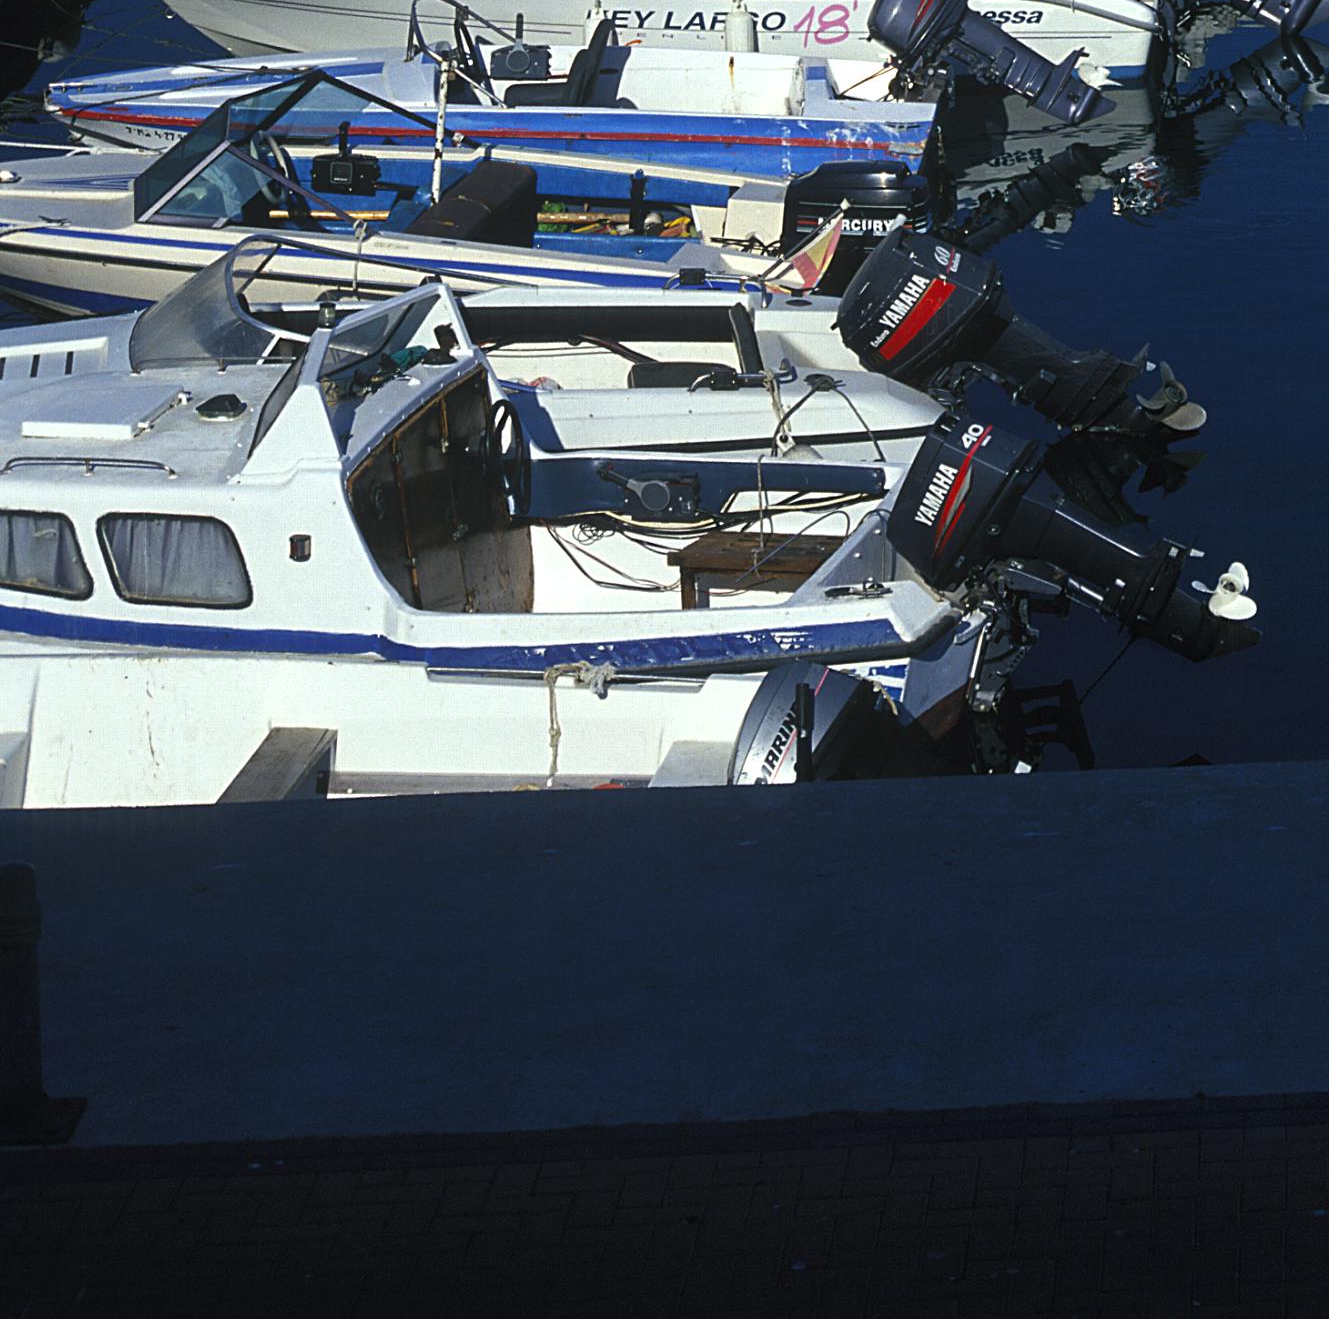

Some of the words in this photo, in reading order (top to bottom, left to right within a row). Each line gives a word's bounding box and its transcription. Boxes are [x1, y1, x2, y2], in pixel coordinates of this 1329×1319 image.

[978, 10, 1043, 24] essa
[818, 217, 895, 231] RCURY
[934, 246, 951, 266] 60
[879, 274, 930, 329] YAMAHA
[961, 423, 984, 449] 40
[915, 463, 958, 526] YAMAHA
[754, 701, 798, 785] ARIN
